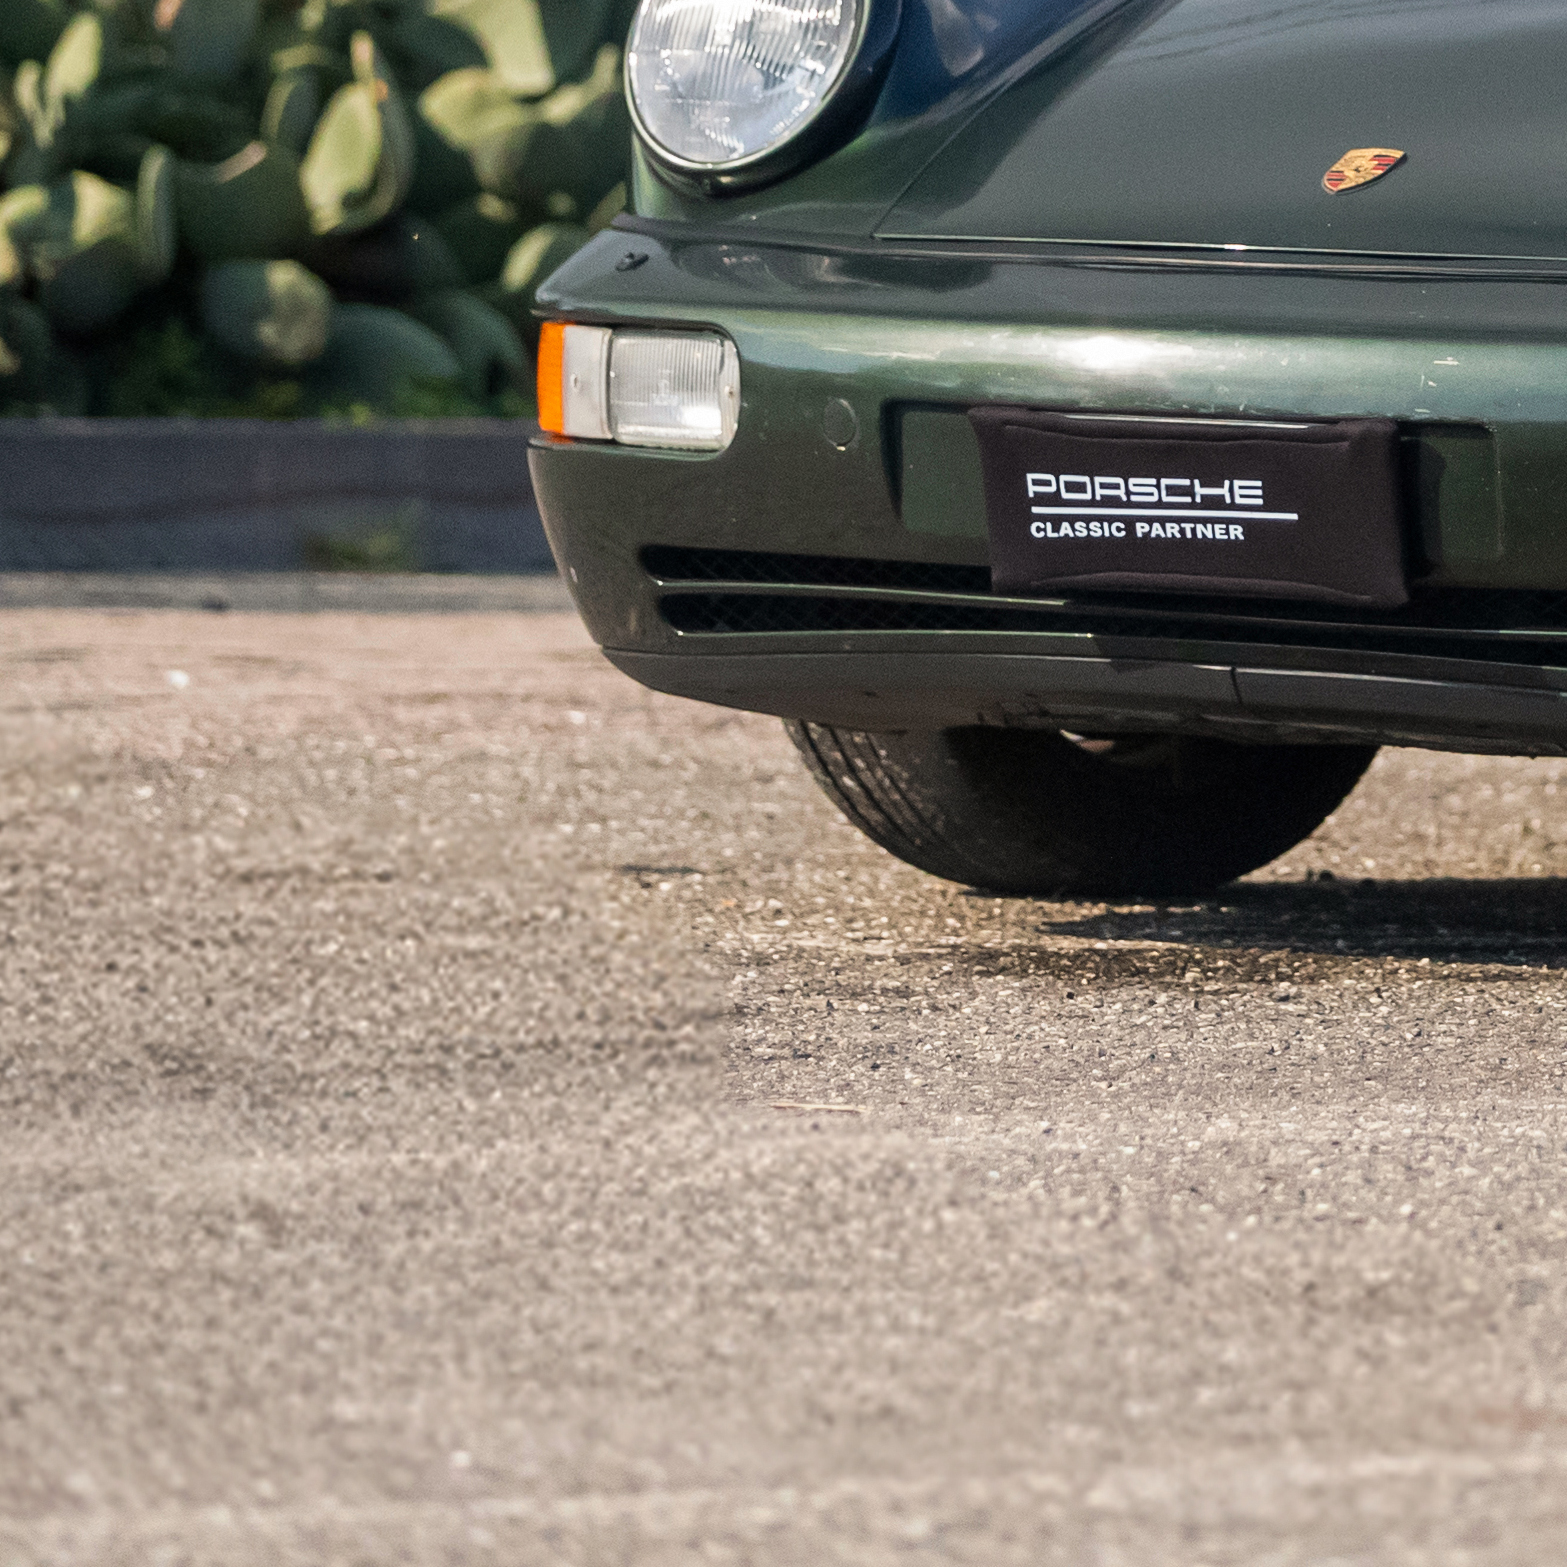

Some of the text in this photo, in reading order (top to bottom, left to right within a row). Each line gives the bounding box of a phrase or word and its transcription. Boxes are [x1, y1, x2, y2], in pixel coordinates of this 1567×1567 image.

[1025, 472, 1264, 506] PORSCHE
[1029, 521, 1245, 541] CLASSIC PARTNER
